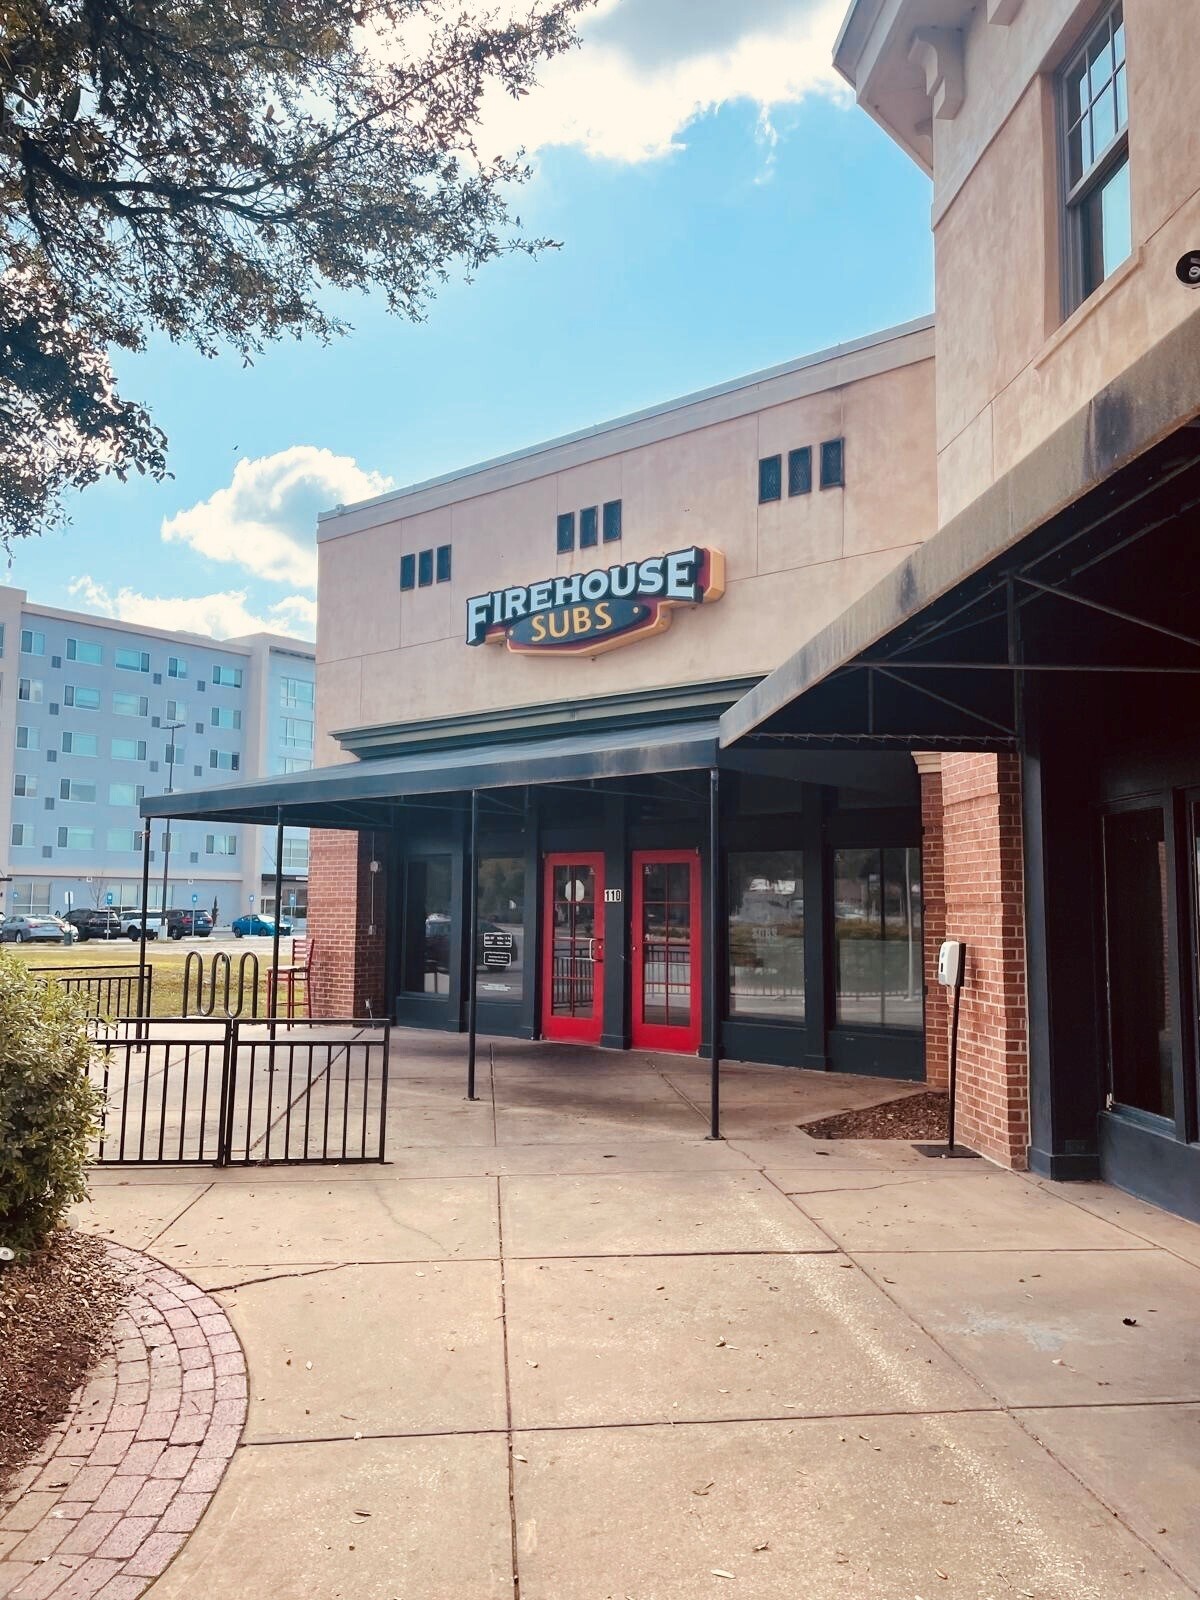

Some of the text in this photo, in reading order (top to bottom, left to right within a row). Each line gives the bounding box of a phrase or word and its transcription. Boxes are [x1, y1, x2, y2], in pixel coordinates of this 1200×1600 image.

[466, 547, 699, 645] FIREHOUSE
[530, 602, 613, 642] SUBS
[605, 890, 621, 901] 110
